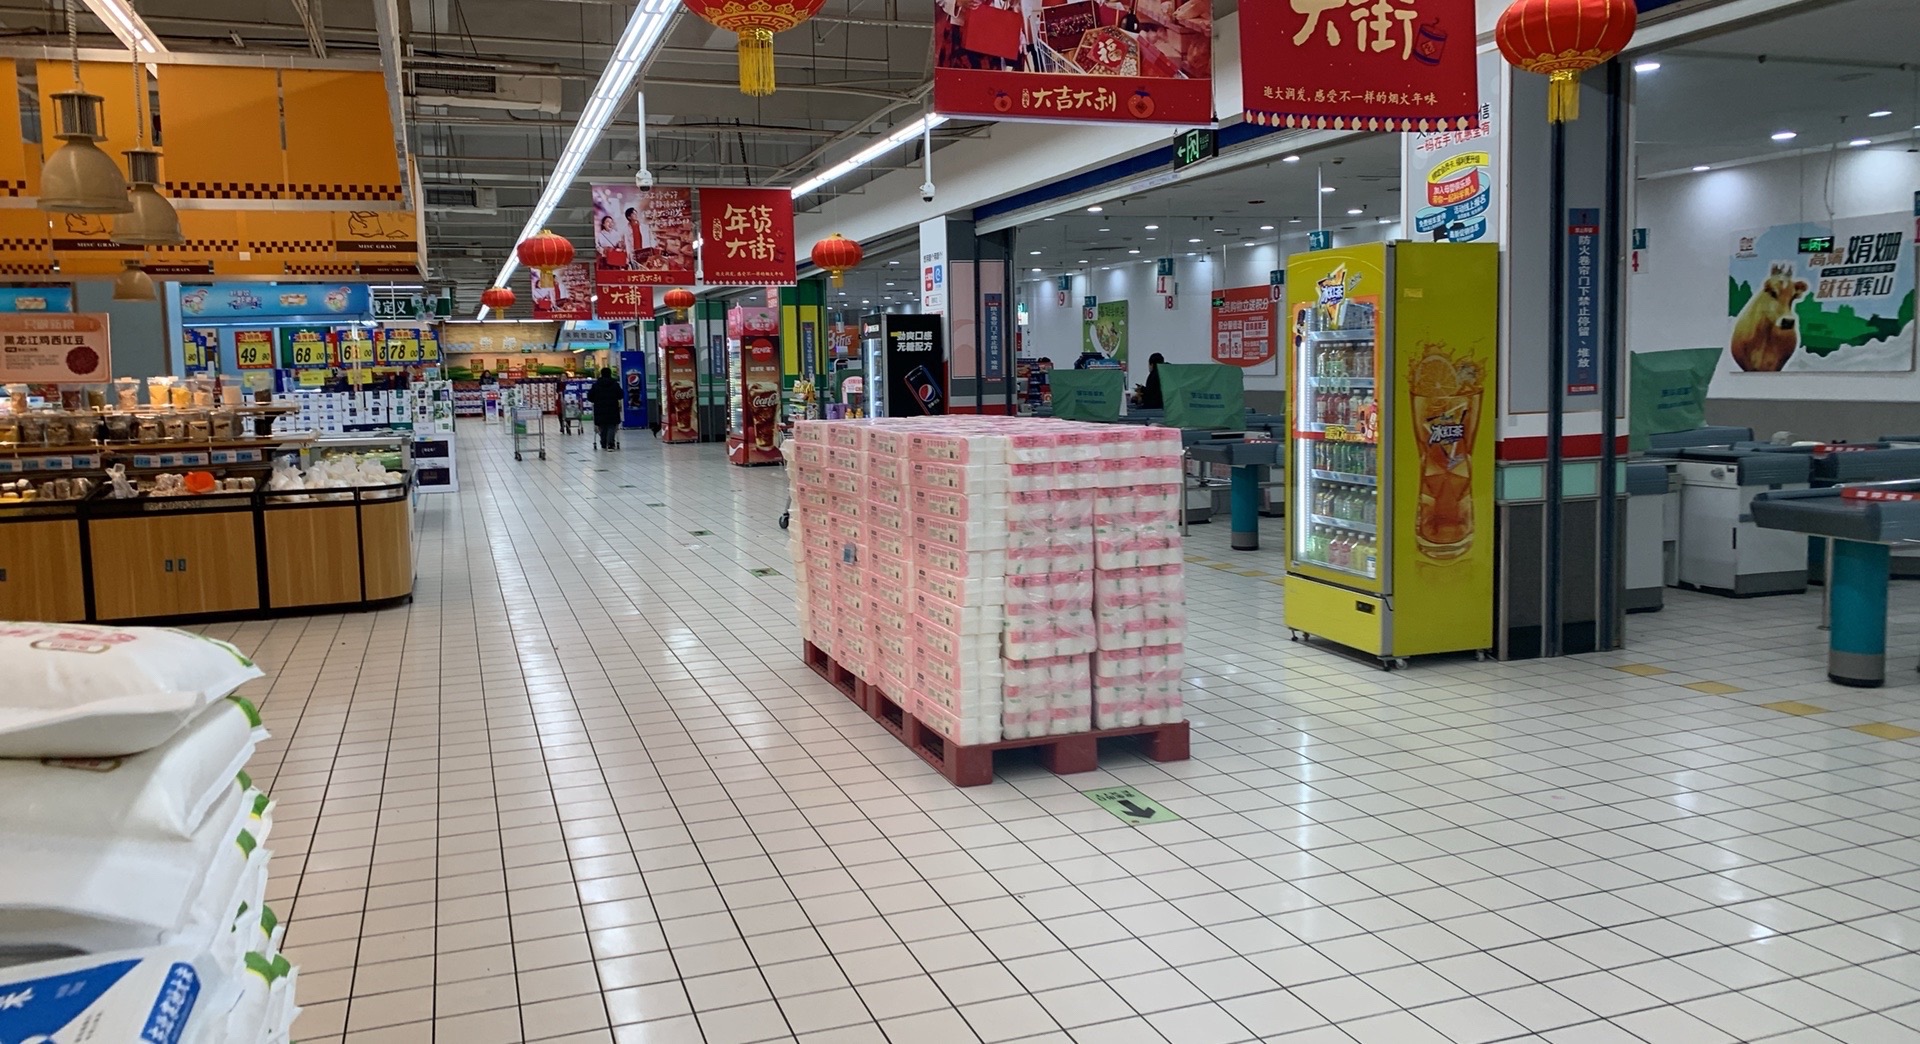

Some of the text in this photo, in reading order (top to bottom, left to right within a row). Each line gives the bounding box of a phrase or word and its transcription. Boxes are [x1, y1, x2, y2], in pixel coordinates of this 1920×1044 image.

[1098, 39, 1123, 64] 福
[1032, 85, 1117, 112] 大吉大利
[1417, 133, 1451, 151] 一码在手
[724, 203, 773, 235] 年货
[725, 234, 776, 262] 大街
[1816, 275, 1894, 298] 就在辉山
[610, 289, 642, 306] 大街
[1577, 235, 1591, 368] 防火卷帘门下禁止停留、堆放
[4, 335, 85, 345] 黑龙江鸡西红豆
[897, 342, 933, 352] 无糖配方
[241, 348, 257, 363] 49
[296, 347, 324, 362] 68 00
[390, 345, 406, 359] 78
